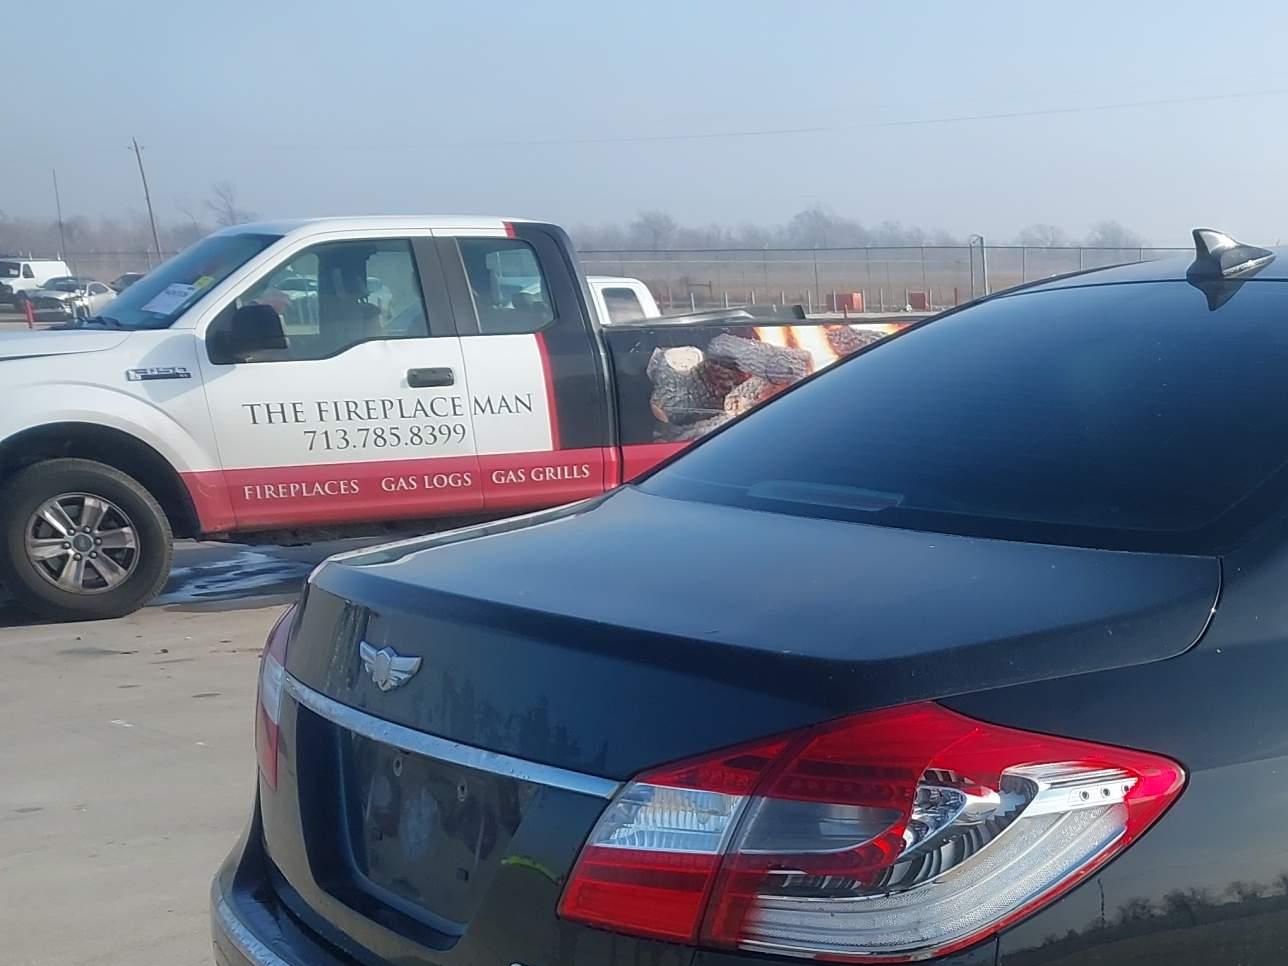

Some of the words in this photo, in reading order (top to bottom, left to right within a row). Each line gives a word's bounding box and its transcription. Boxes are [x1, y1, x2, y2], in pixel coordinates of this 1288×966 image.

[241, 403, 306, 425] THE
[316, 397, 465, 422] FIREPLACE
[472, 393, 533, 415] MAN
[303, 423, 467, 451] 713.785.8399
[243, 479, 360, 500] FIREPLACES
[381, 476, 417, 492] GAS
[424, 472, 472, 489] LOGS
[492, 468, 525, 484] GAS
[531, 464, 591, 481] GRILLS
